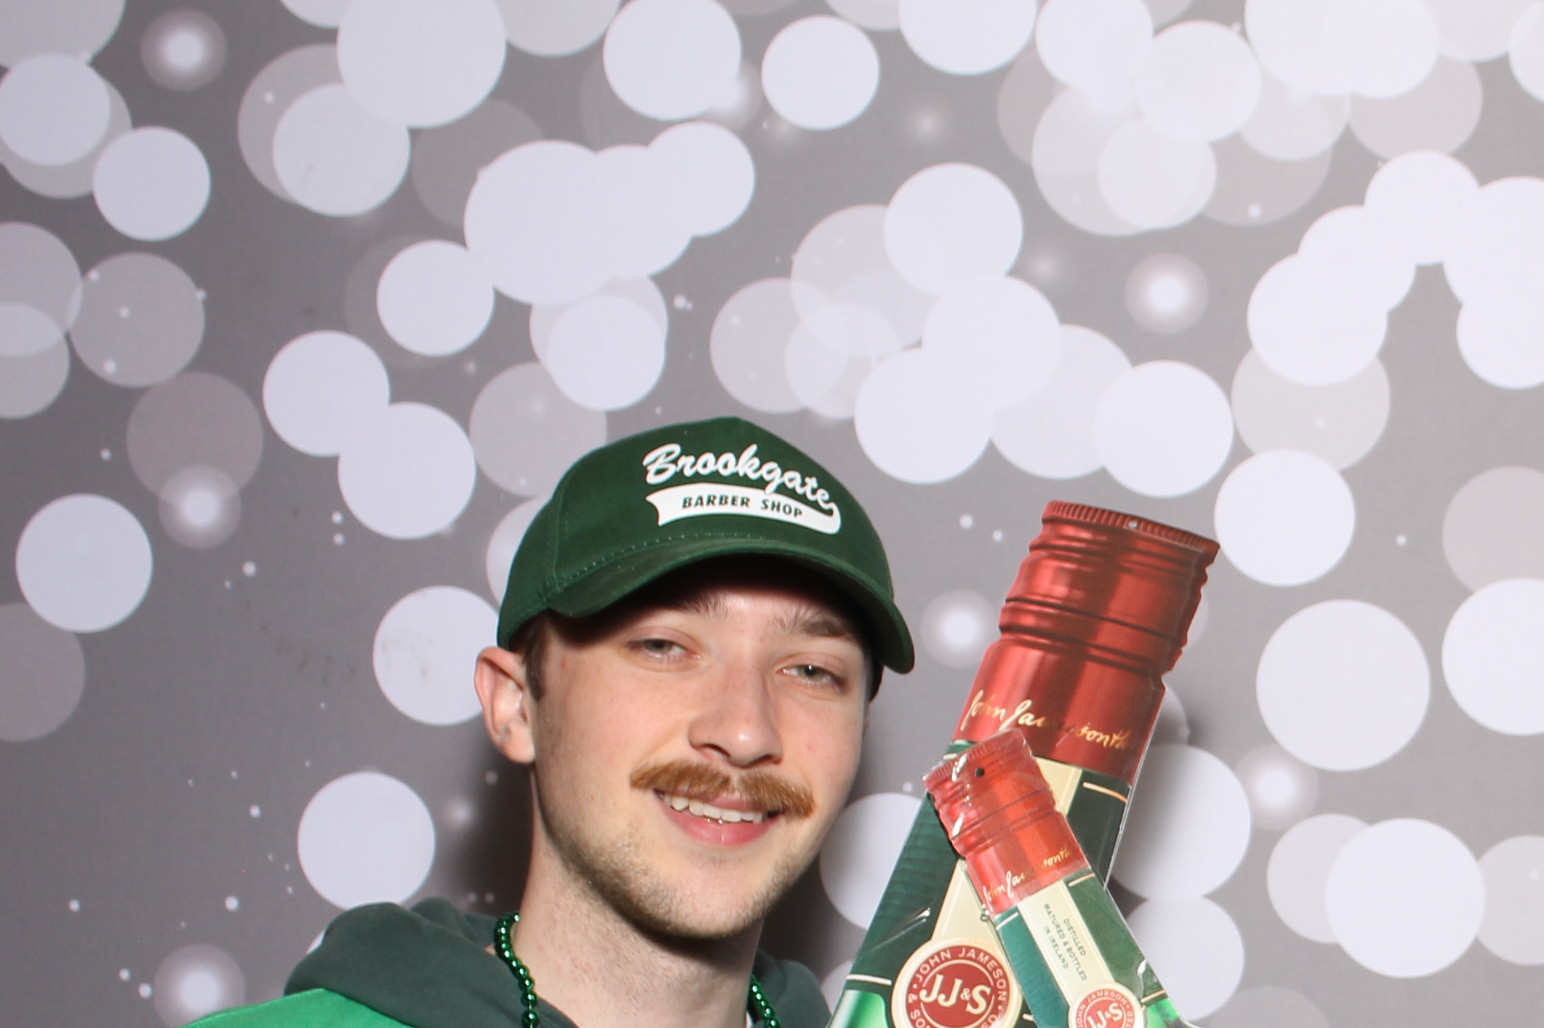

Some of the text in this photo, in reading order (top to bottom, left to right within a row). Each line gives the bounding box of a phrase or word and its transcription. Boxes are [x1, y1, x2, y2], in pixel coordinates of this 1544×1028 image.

[643, 443, 833, 507] Brookgate
[681, 494, 803, 519] BARBER SHOP
[1044, 903, 1065, 939] MATURED
[1066, 946, 1087, 980] BOTTLED
[1063, 918, 1086, 956] DISTILLED
[916, 947, 1007, 1001] JOHN JAMESON
[919, 973, 992, 1015] JJ&S
[1076, 989, 1128, 1028] JOHN JAMESON
